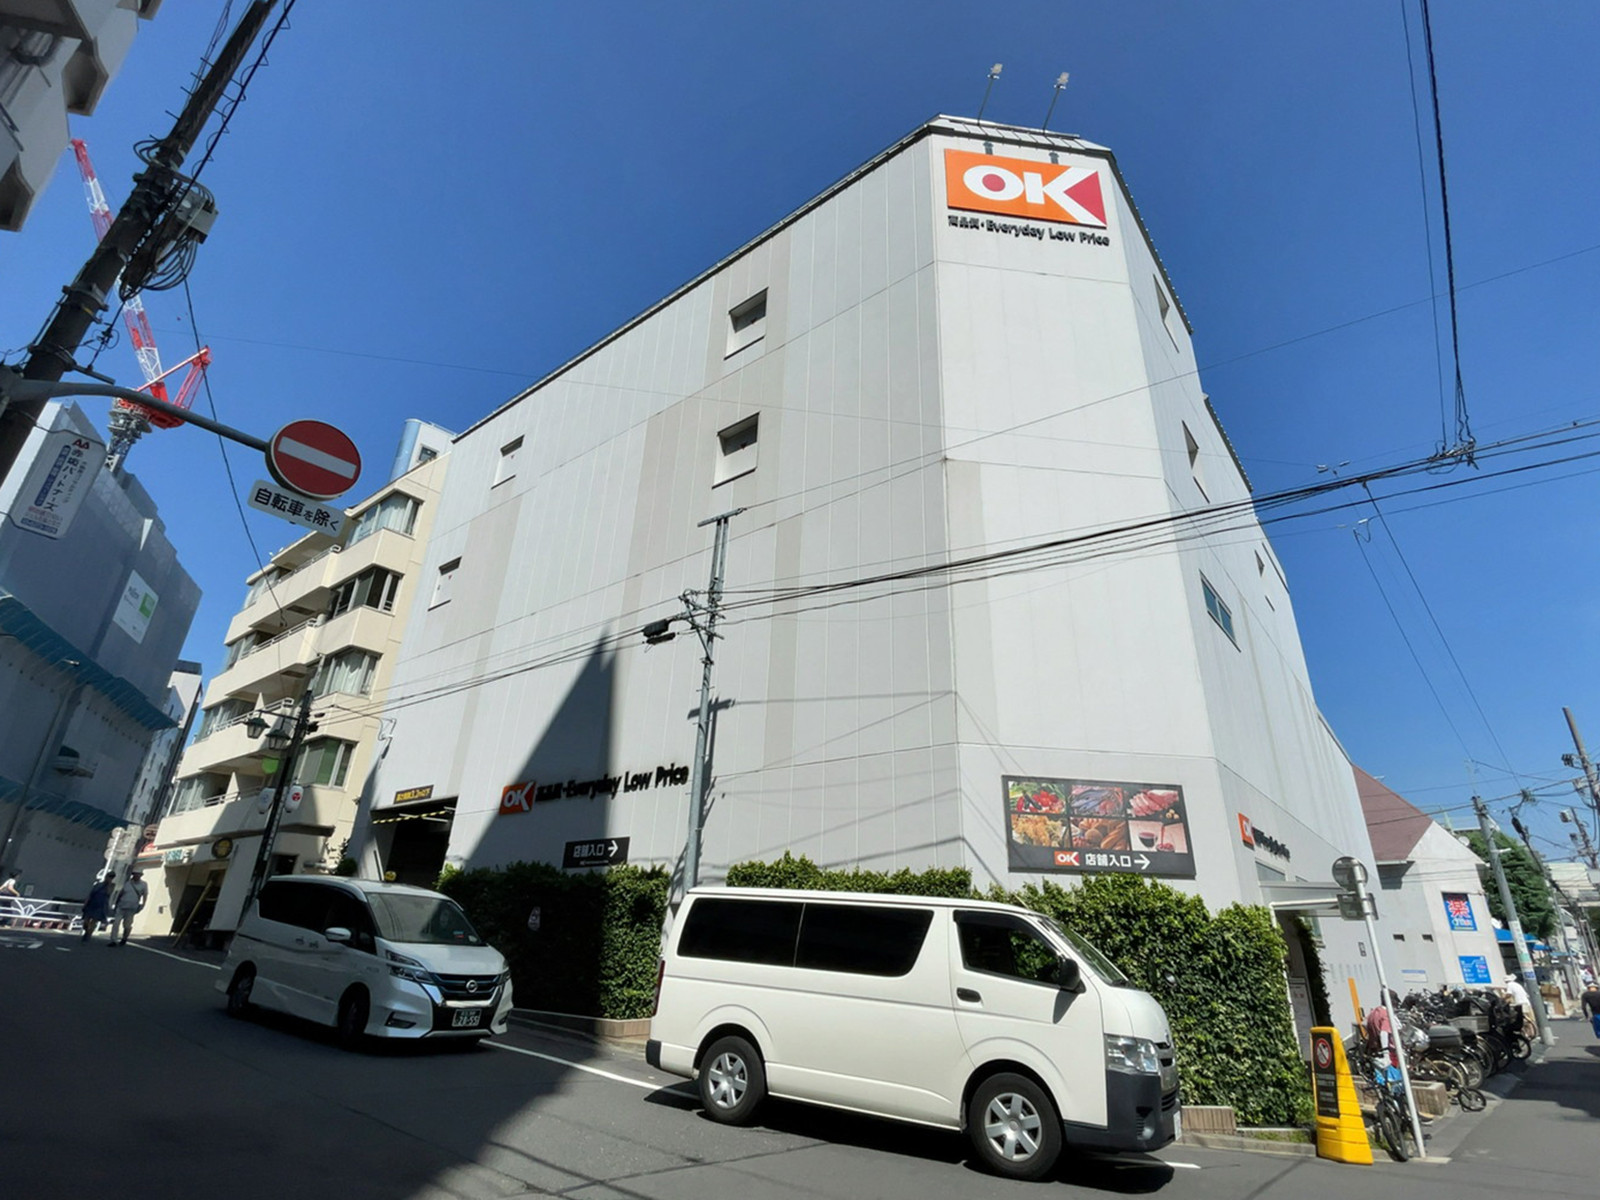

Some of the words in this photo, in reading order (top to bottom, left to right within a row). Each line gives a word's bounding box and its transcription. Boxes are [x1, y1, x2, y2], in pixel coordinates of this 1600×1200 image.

[963, 165, 1107, 227] OK
[1049, 227, 1076, 243] Low
[1079, 231, 1110, 247] Price
[254, 487, 340, 532] 自転車を除く
[623, 769, 654, 793] Low
[655, 762, 690, 790] Price
[503, 780, 535, 812] OK
[1057, 851, 1080, 866] OK
[1085, 853, 1132, 867] 店舗入口
